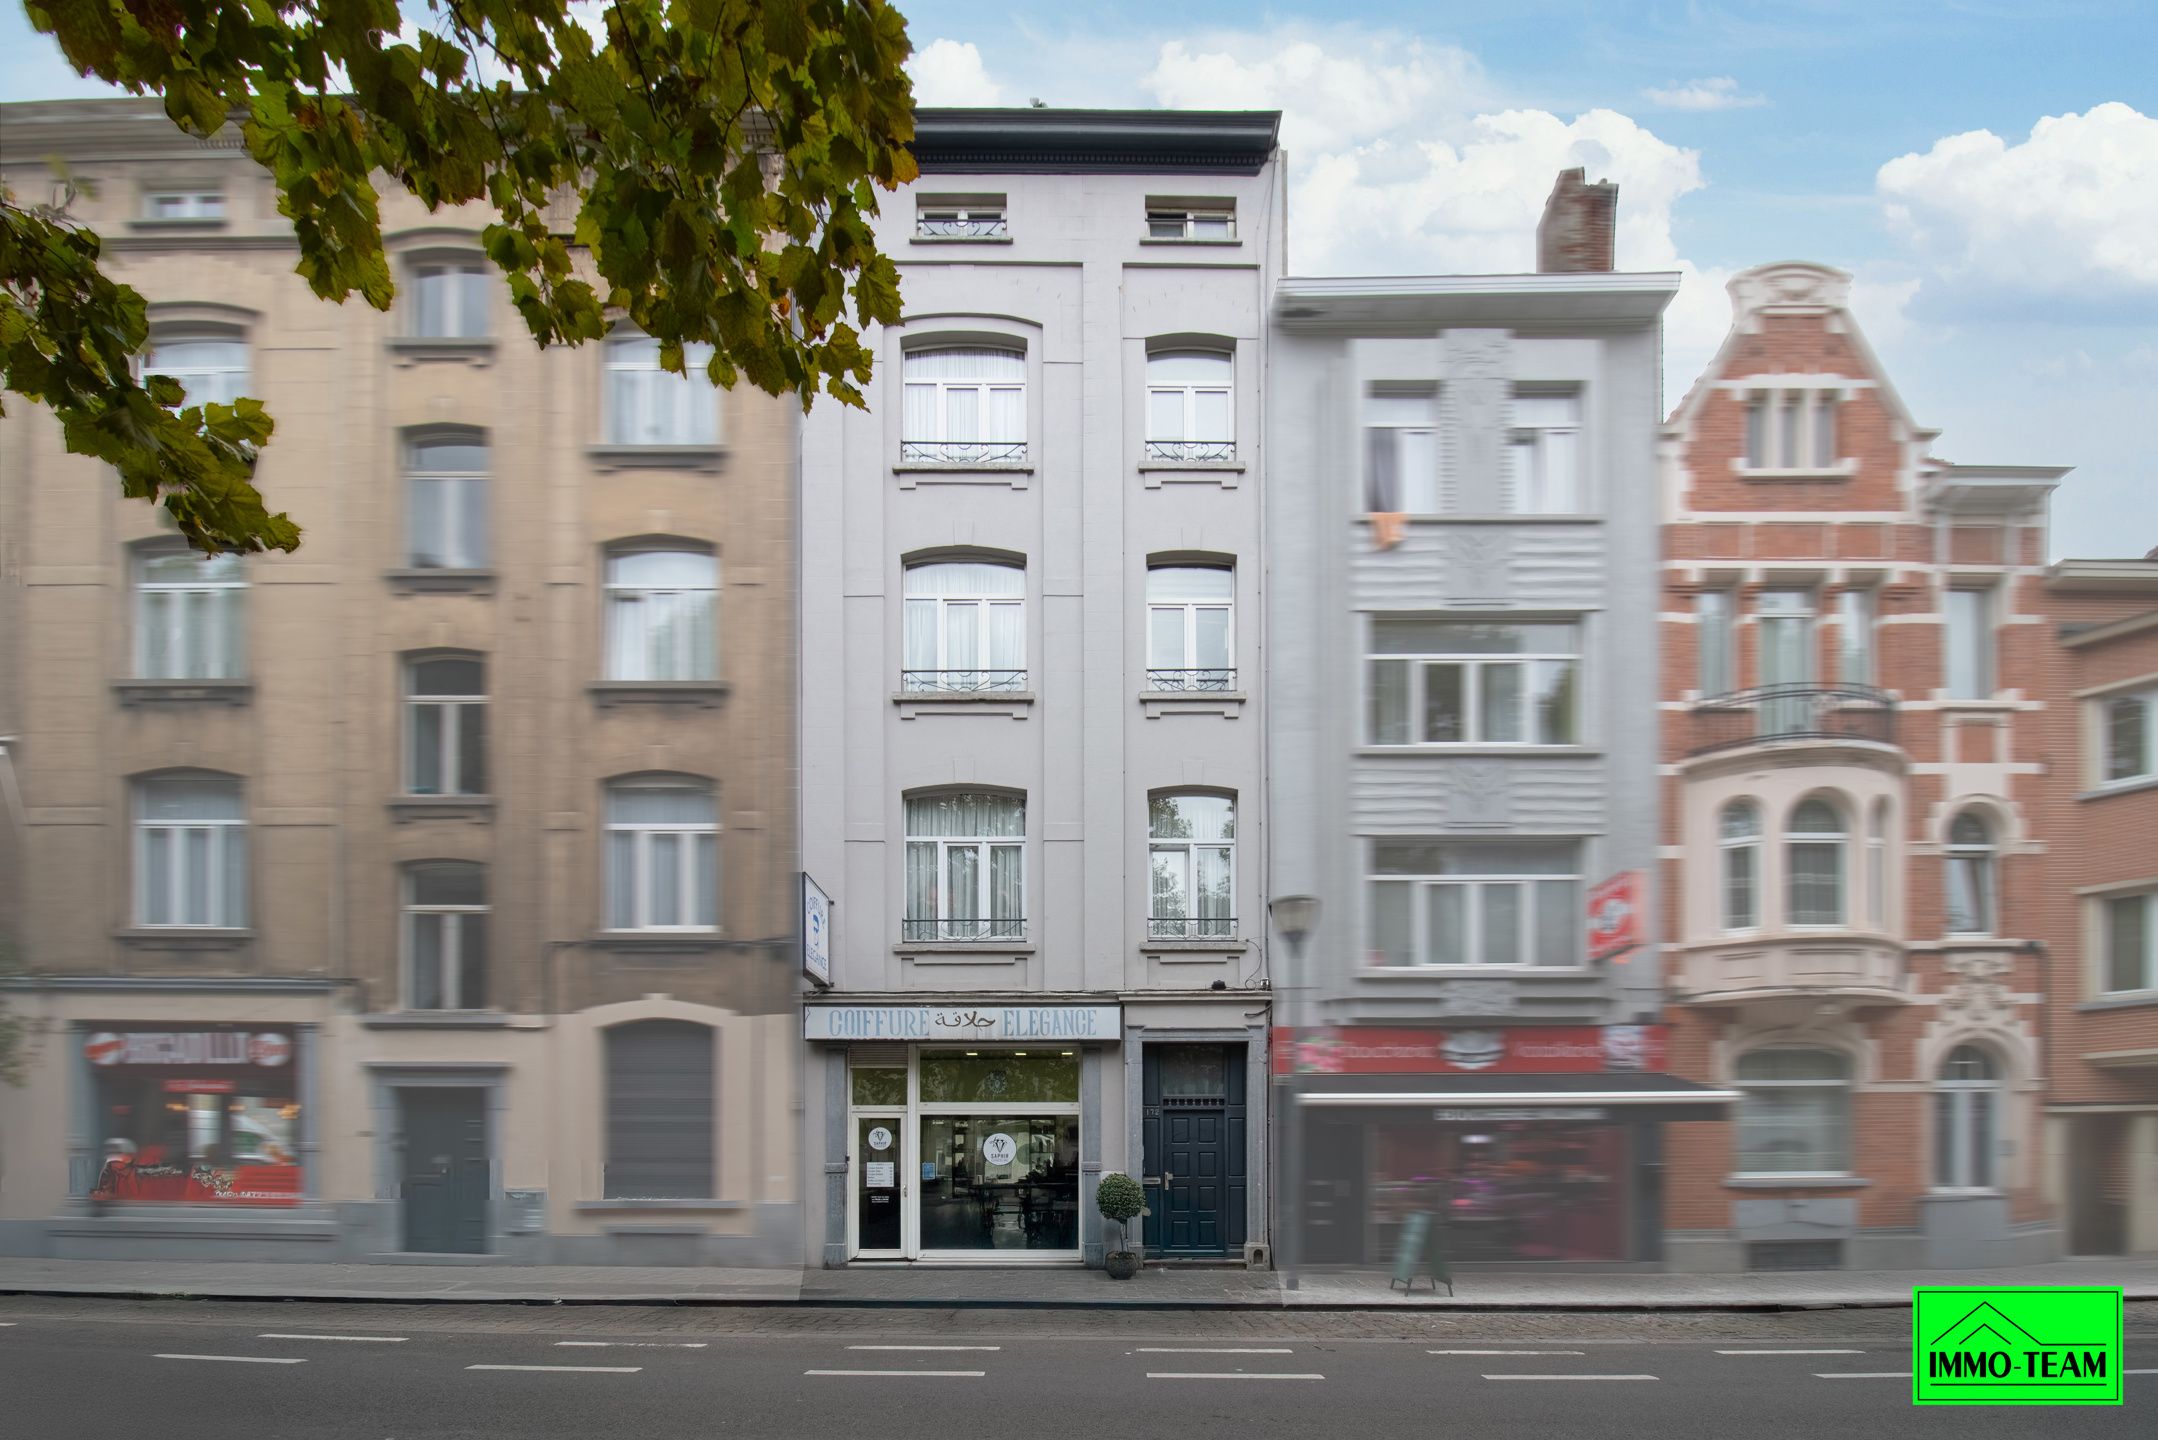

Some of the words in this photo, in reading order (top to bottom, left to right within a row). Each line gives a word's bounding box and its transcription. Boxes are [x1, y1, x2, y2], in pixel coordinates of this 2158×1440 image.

[828, 1009, 930, 1036] COIFFURE
[934, 1010, 996, 1031] حلاقة
[1003, 1009, 1097, 1036] ELEGANCE
